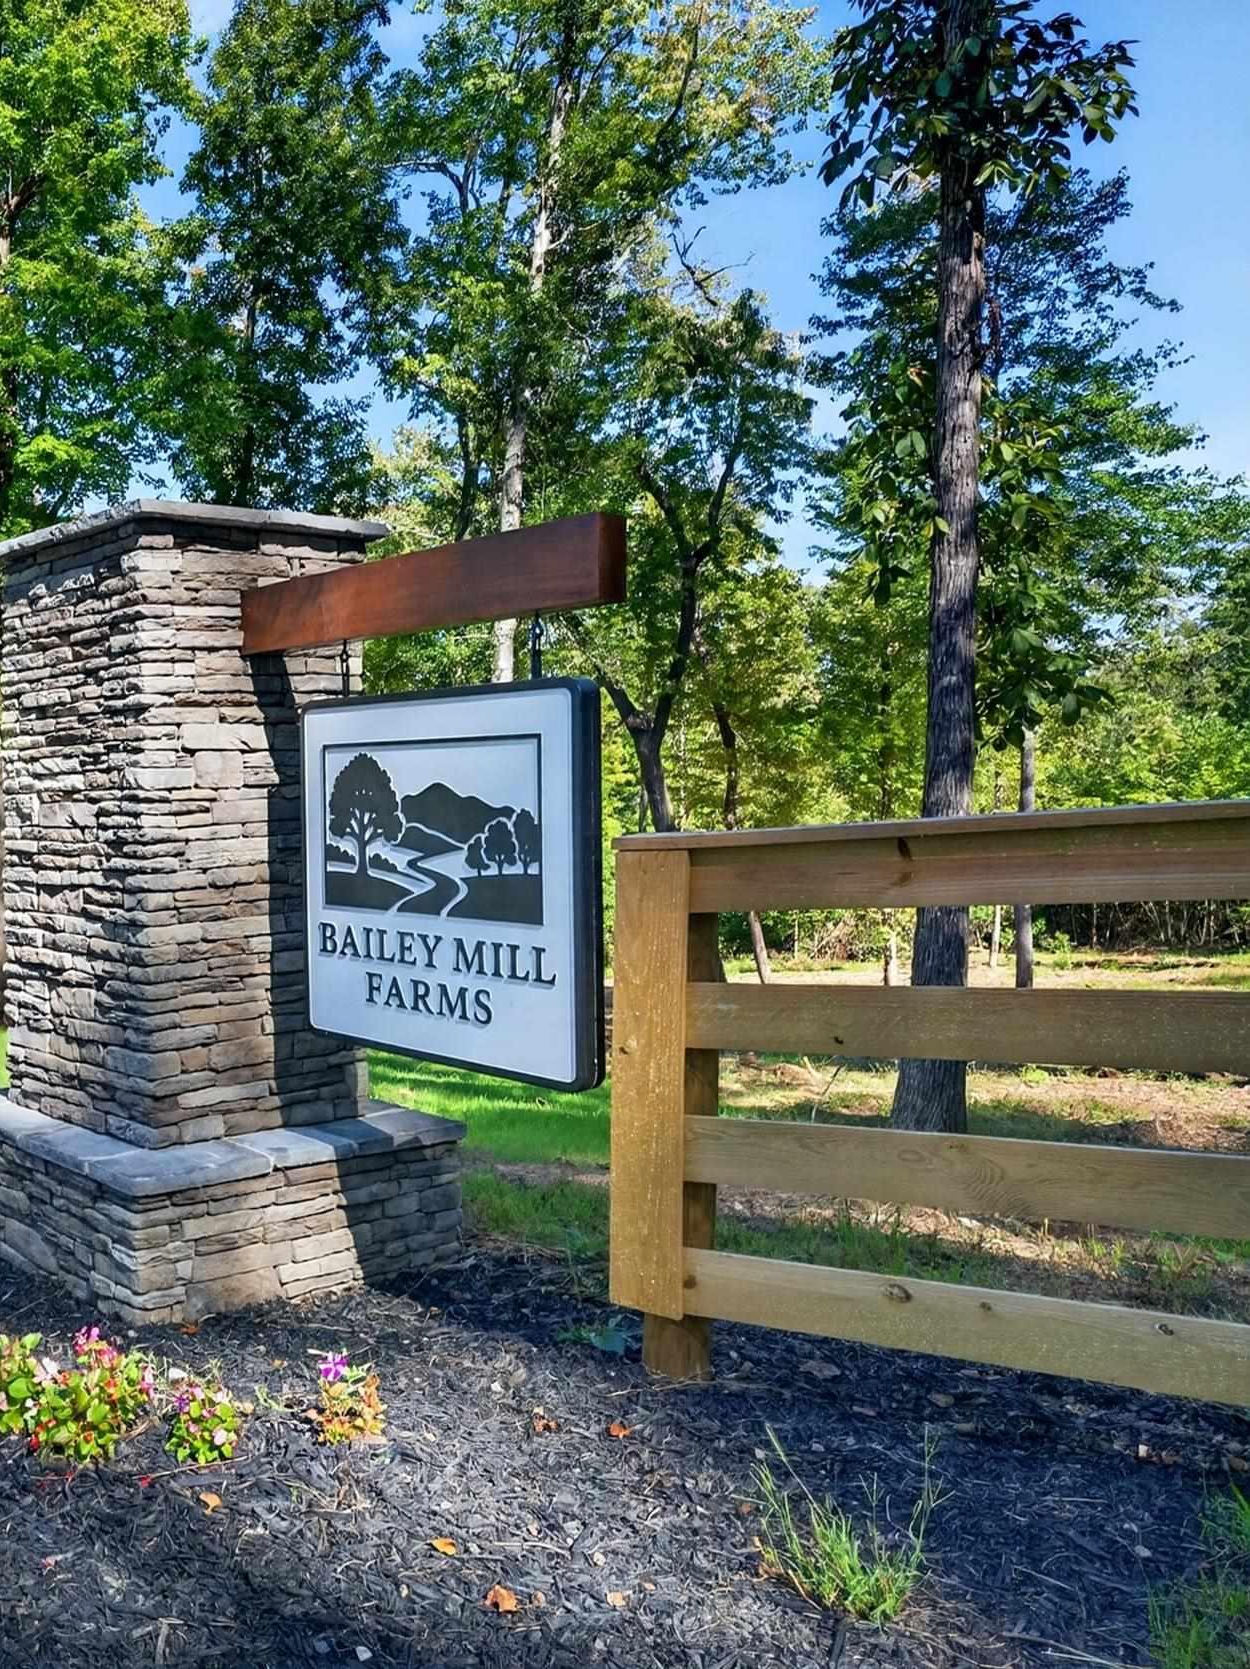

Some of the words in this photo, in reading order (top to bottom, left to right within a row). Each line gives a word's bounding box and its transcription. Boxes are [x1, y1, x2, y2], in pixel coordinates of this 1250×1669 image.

[318, 922, 442, 969] BAILEY
[453, 938, 557, 985] MILL
[365, 971, 492, 1025] FARMS
